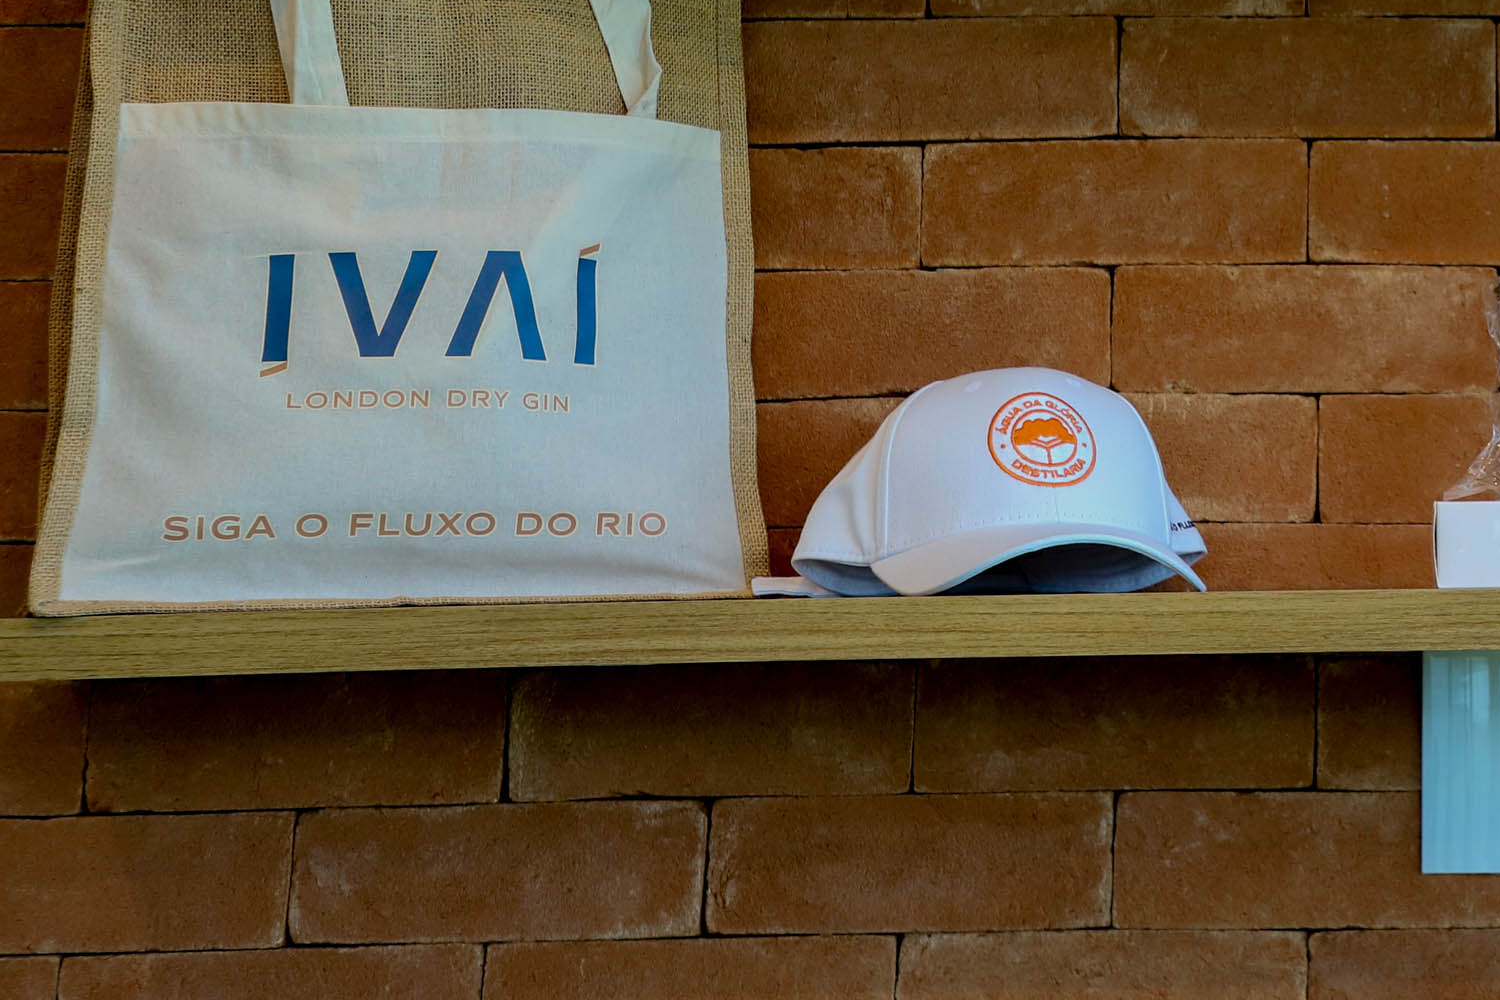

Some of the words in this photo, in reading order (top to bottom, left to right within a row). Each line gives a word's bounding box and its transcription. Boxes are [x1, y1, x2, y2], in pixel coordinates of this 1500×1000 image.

[286, 389, 431, 410] LONDON
[447, 389, 510, 408] DRY
[522, 392, 570, 412] GIN
[162, 514, 276, 541] SIGA
[296, 513, 329, 539] O
[349, 512, 496, 538] FLUXO
[515, 512, 577, 536] DO
[596, 512, 667, 537] RIO
